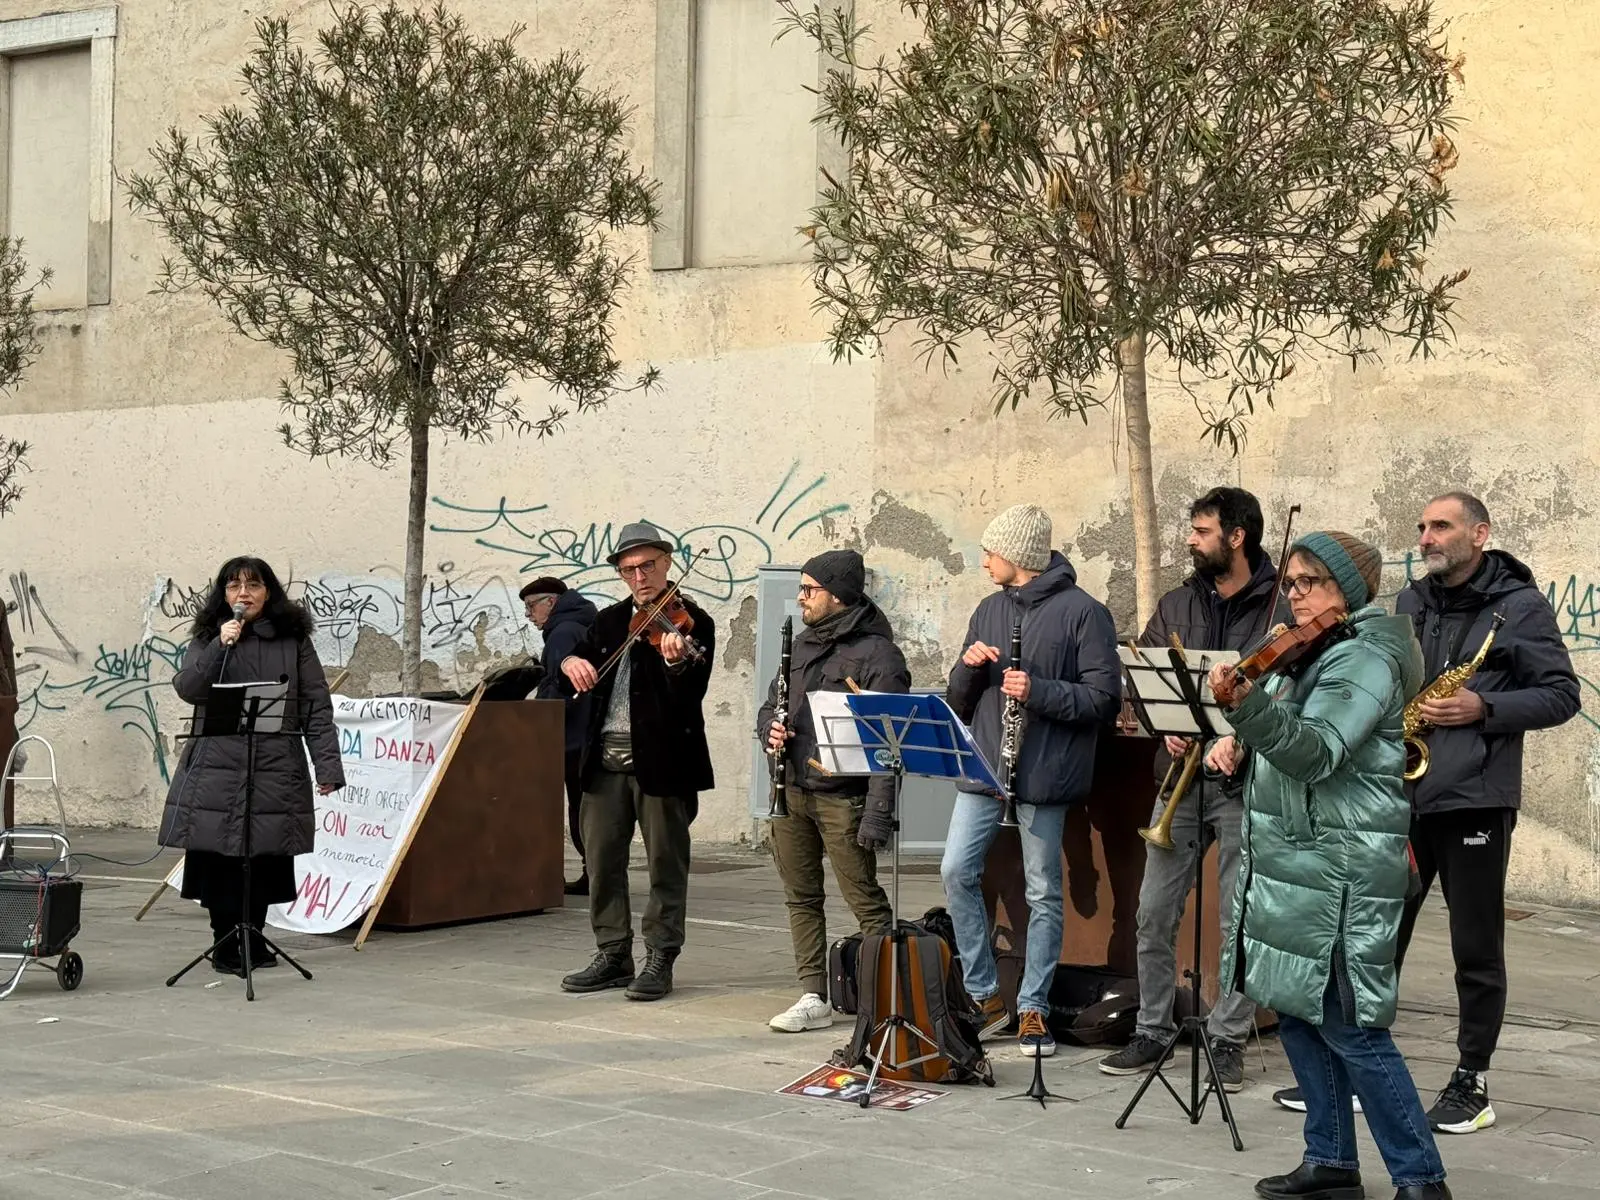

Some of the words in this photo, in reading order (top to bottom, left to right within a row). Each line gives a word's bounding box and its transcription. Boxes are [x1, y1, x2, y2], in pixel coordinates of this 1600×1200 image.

[360, 700, 431, 724] MEMORIA
[335, 726, 362, 759] DA
[375, 736, 436, 766] DANZA
[356, 818, 393, 840] noi
[1463, 837, 1486, 845] PUMA
[318, 847, 386, 870] memoria
[286, 871, 352, 921] MAI
